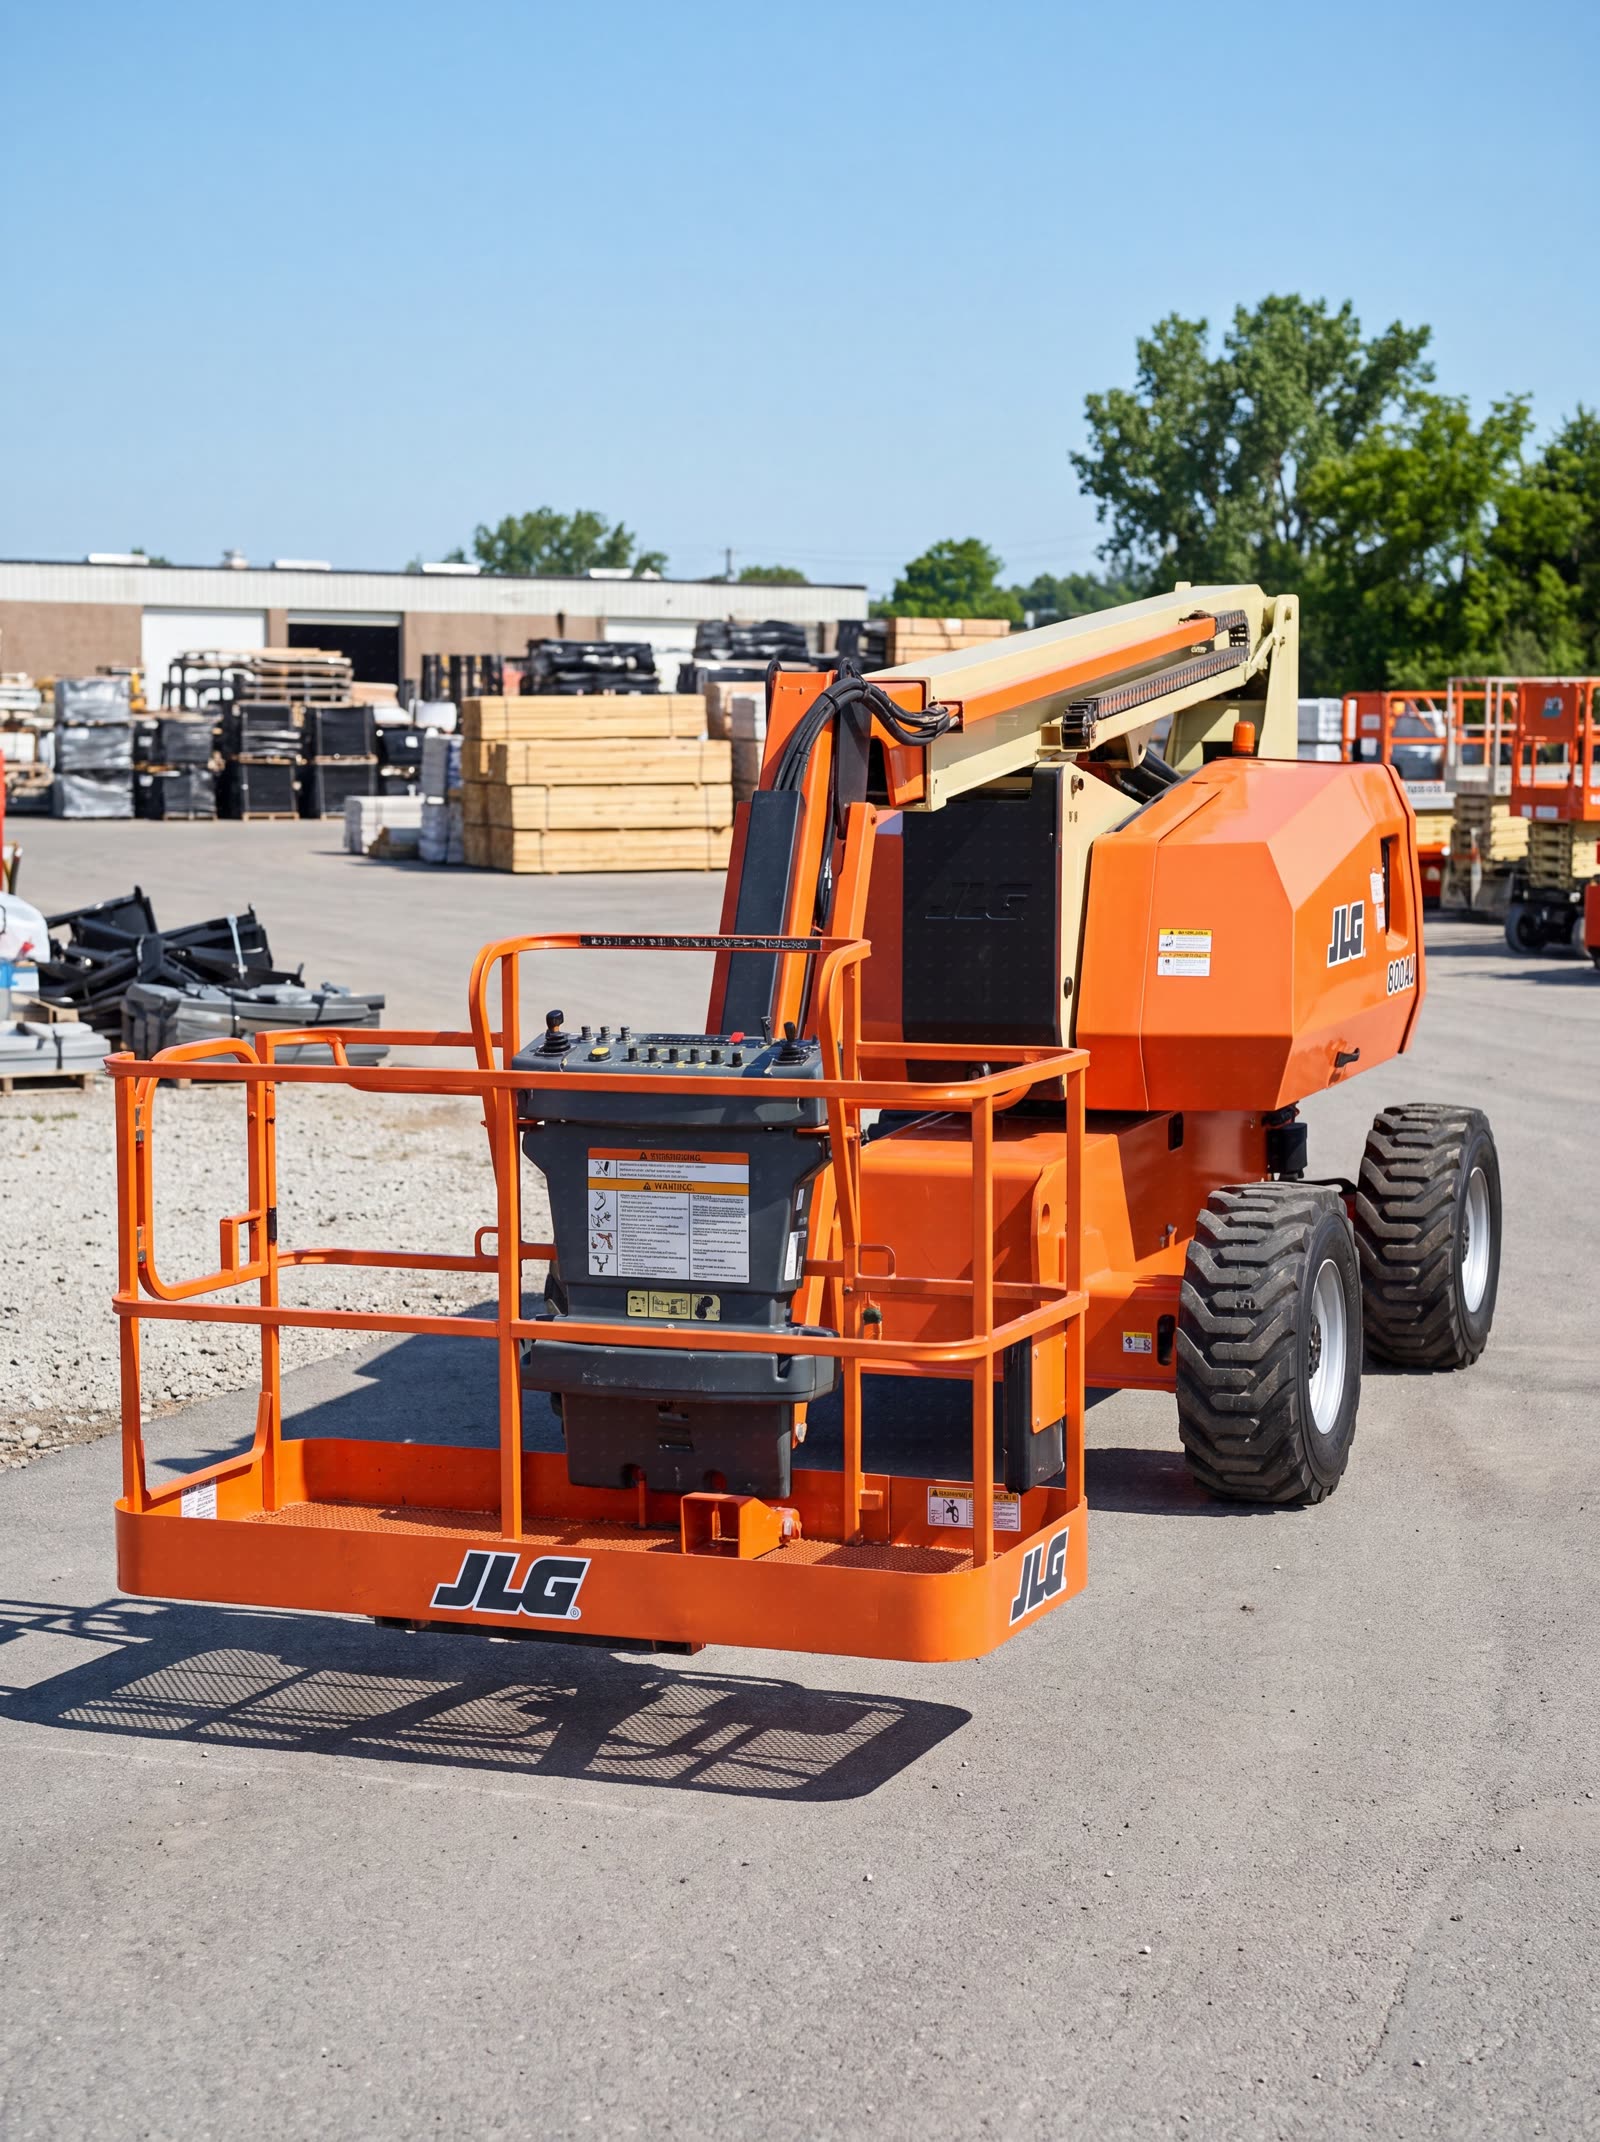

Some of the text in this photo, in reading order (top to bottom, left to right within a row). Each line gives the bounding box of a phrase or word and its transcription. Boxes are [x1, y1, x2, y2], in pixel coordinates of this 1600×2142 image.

[925, 883, 1031, 920] JLG
[1327, 901, 1365, 968] JLG
[1387, 954, 1416, 996] 800AJ
[430, 1549, 591, 1619] JLG
[1009, 1526, 1069, 1626] JLG
